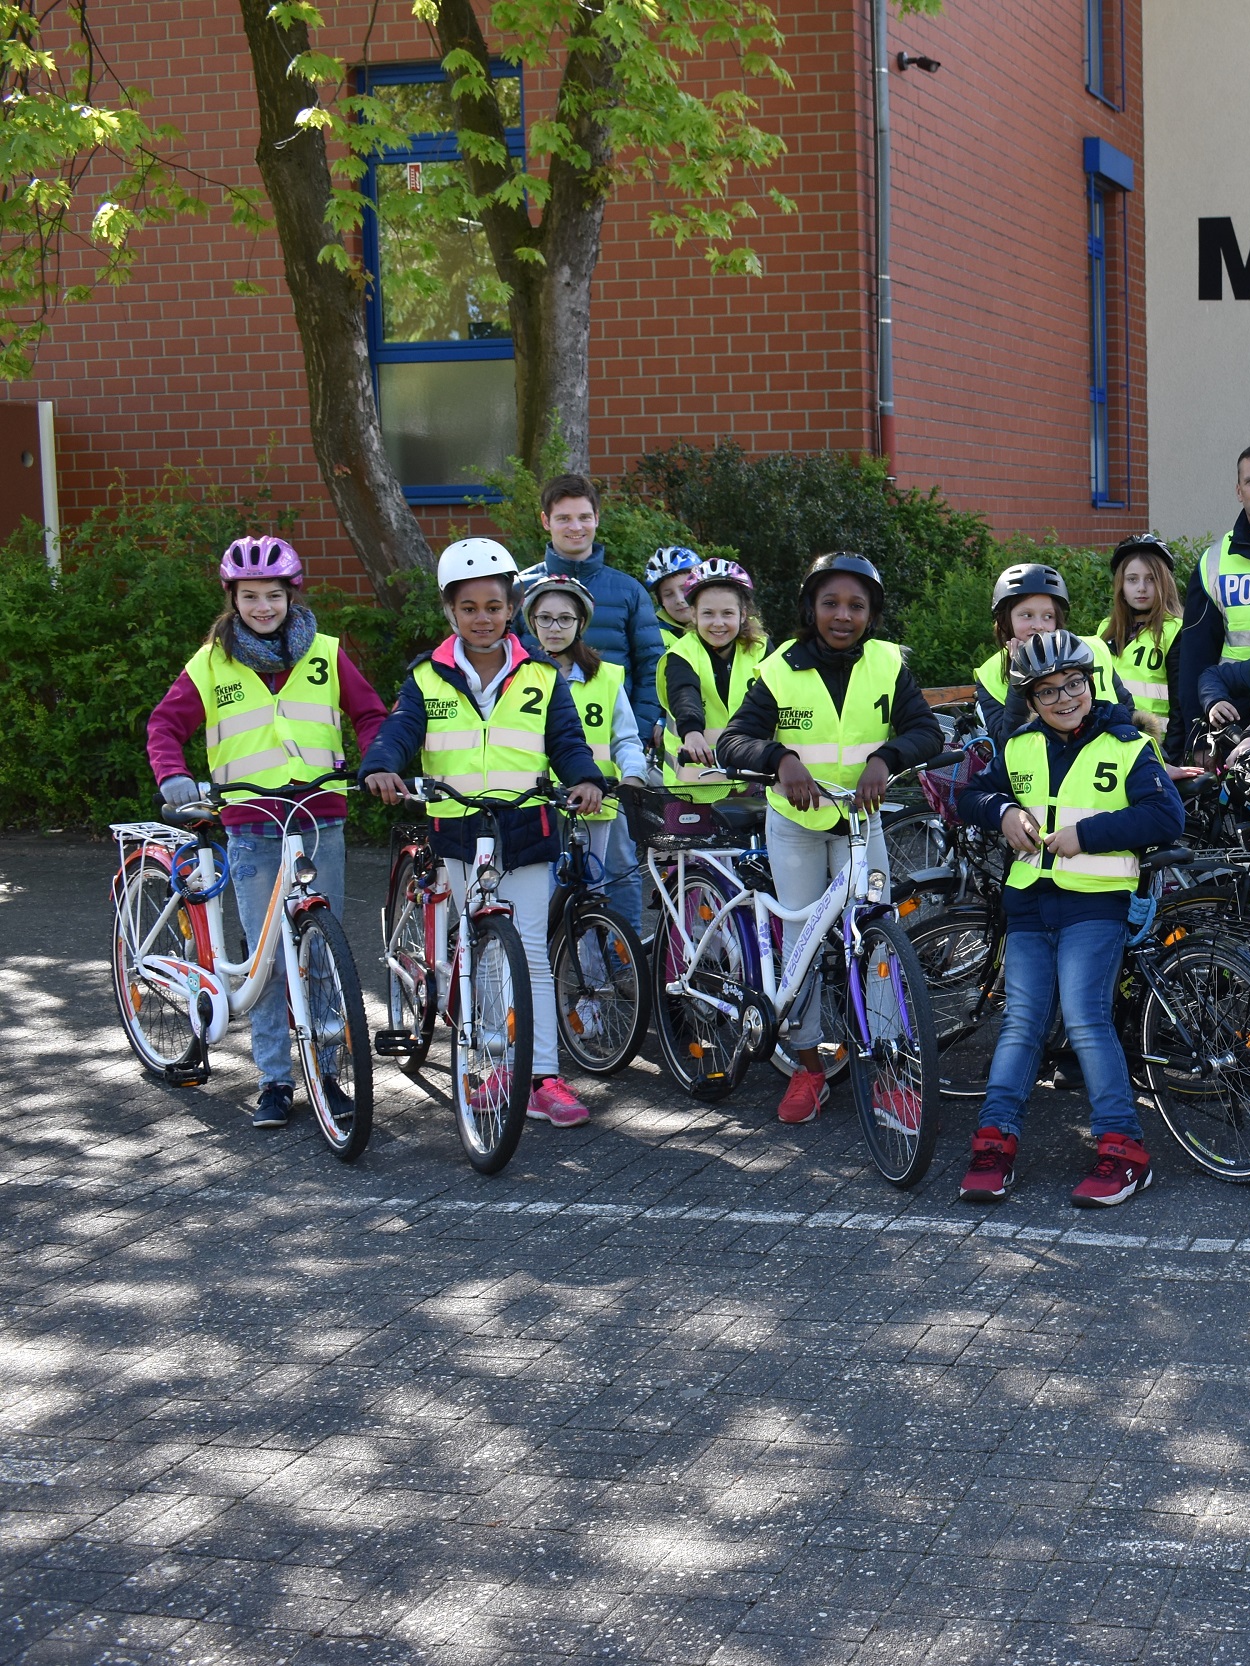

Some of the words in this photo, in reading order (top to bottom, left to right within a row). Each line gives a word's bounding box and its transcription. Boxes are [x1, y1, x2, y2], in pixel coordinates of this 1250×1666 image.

[306, 656, 329, 686] 3
[1133, 645, 1164, 671] 10
[519, 686, 544, 715] 2
[584, 702, 604, 728] 8
[873, 693, 890, 725] 1
[1092, 761, 1118, 793] 5
